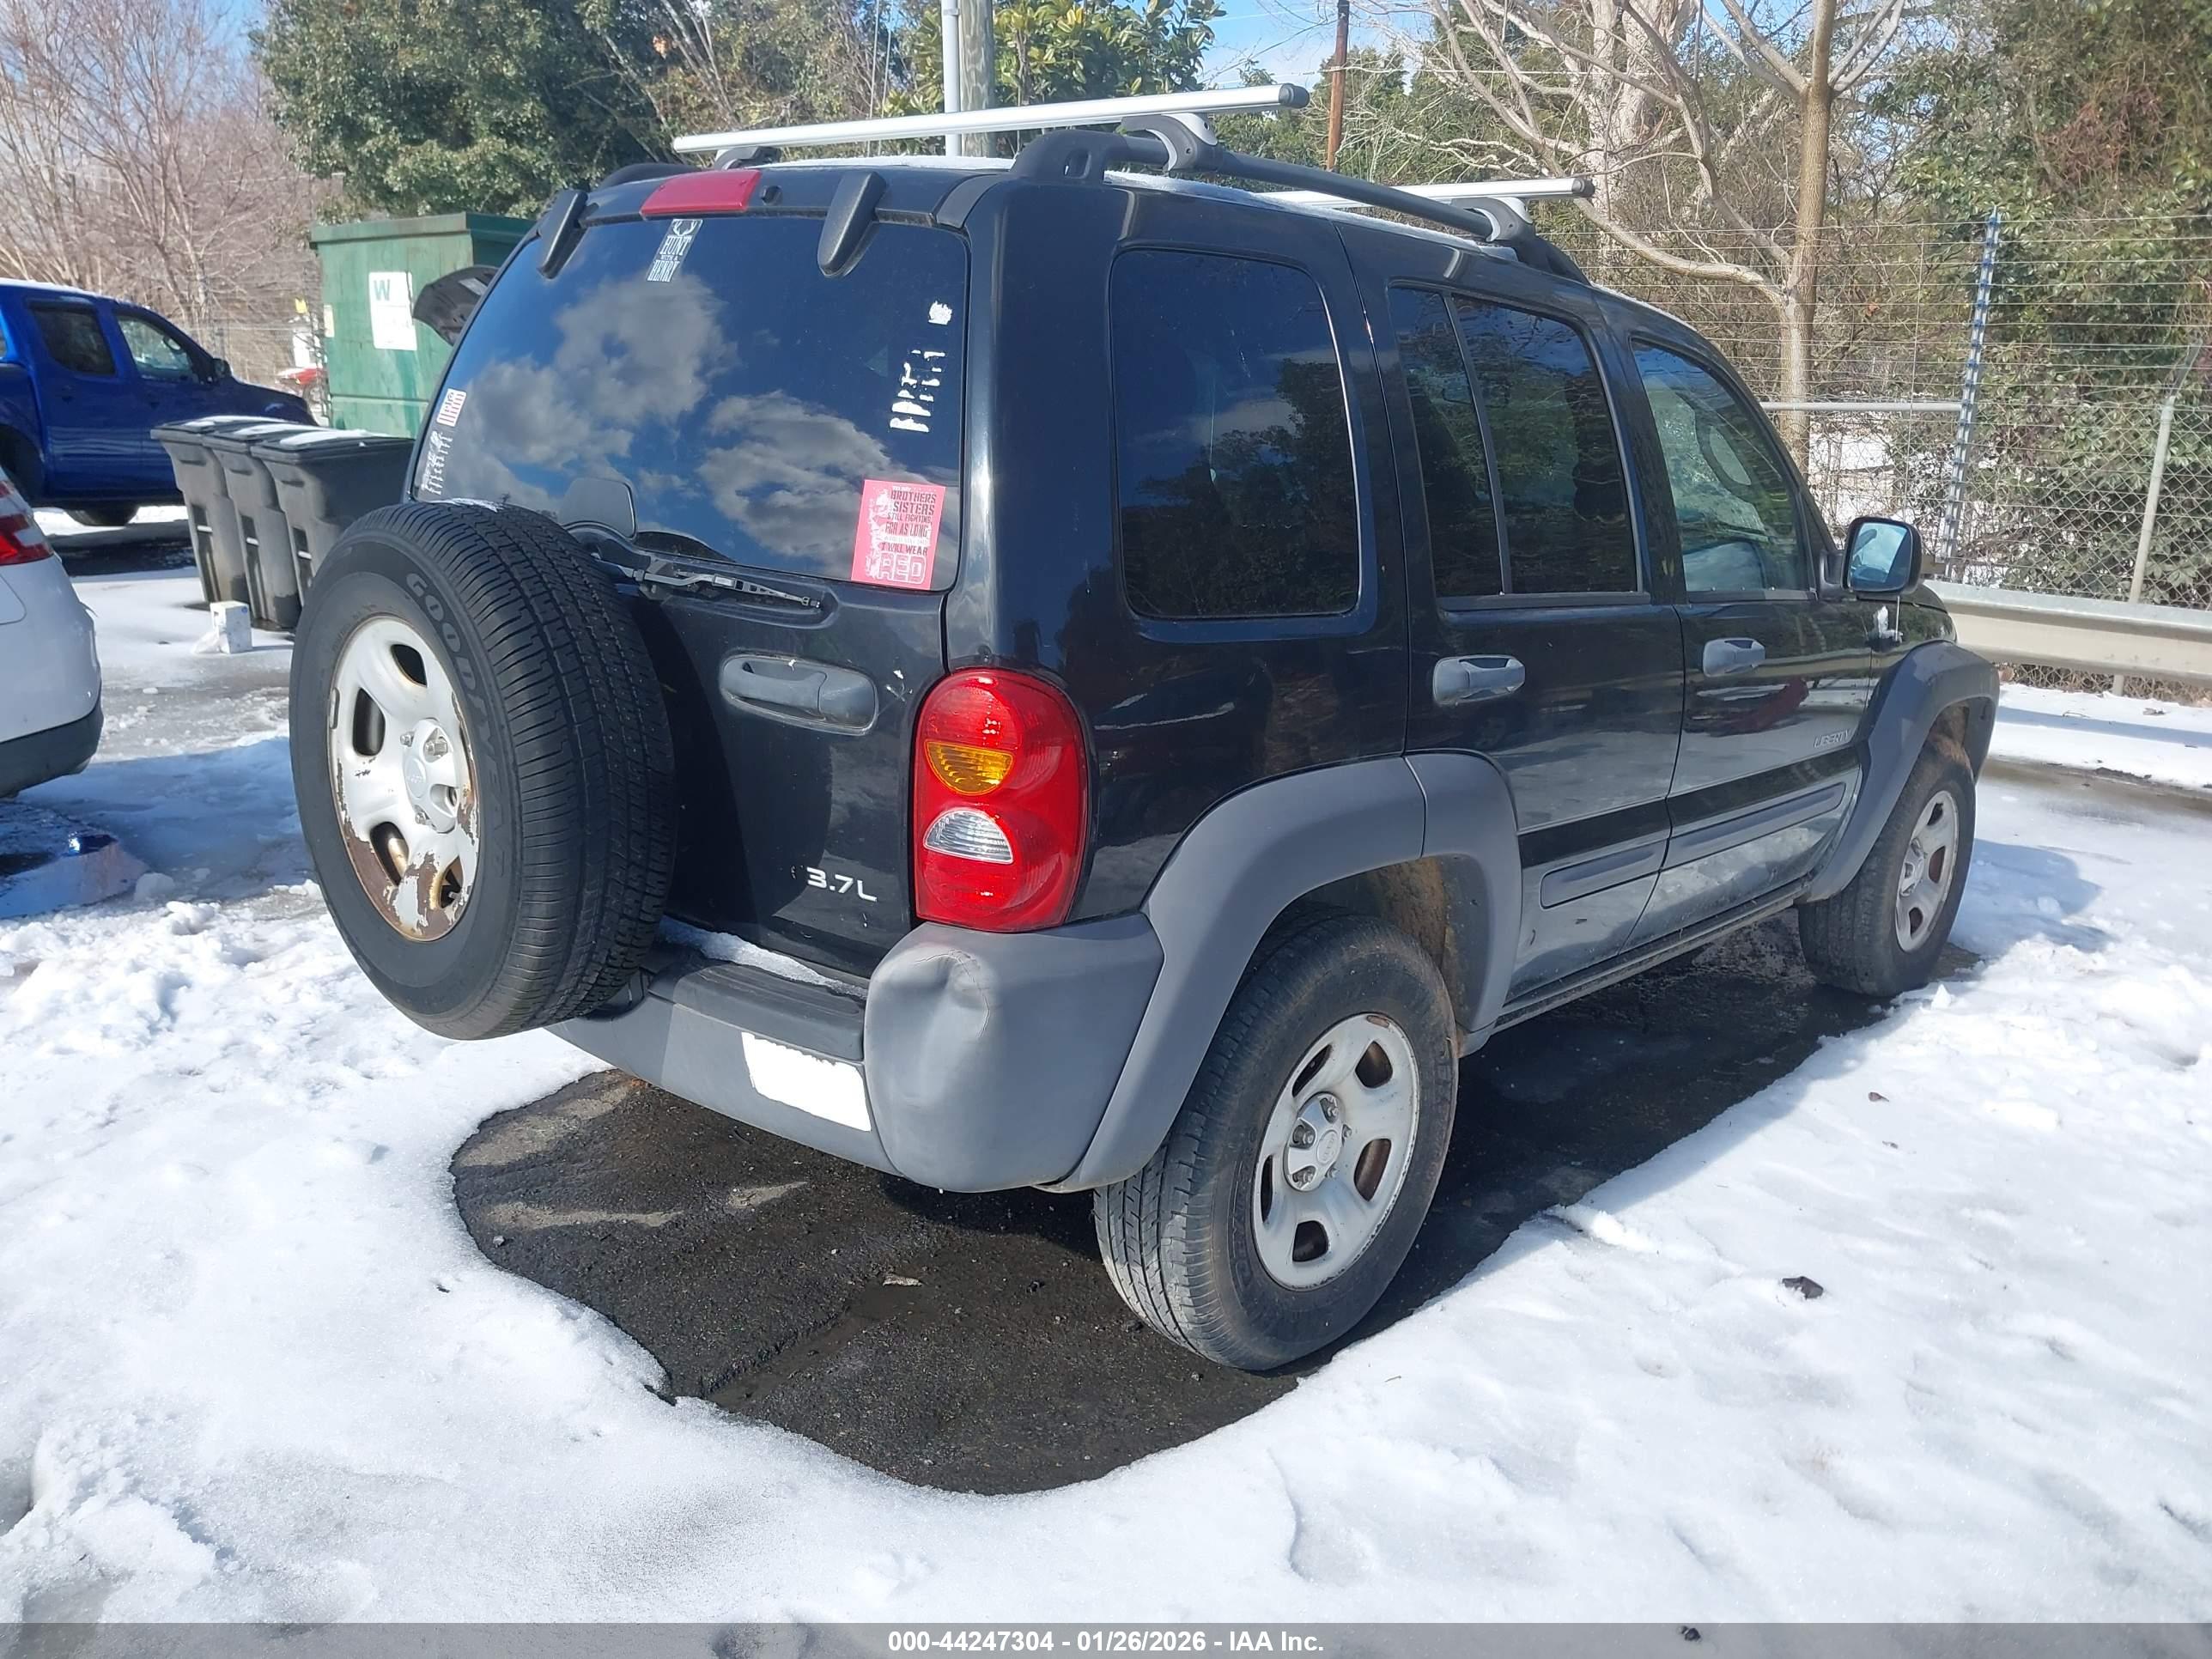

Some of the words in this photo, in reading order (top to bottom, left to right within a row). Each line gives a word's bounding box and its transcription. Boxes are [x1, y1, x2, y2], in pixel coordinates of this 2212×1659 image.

[659, 235, 692, 256] HUNT
[647, 259, 680, 282] HENRY
[890, 490, 937, 504] BROTHERS
[893, 501, 935, 515] SISTERS
[887, 513, 902, 521] STILL
[899, 523, 909, 536] AS
[887, 543, 904, 553] WILL
[906, 545, 928, 556] WEAR
[878, 552, 927, 584] RED
[1814, 729, 1850, 748] LIBERTY
[806, 866, 878, 902] 3.7L
